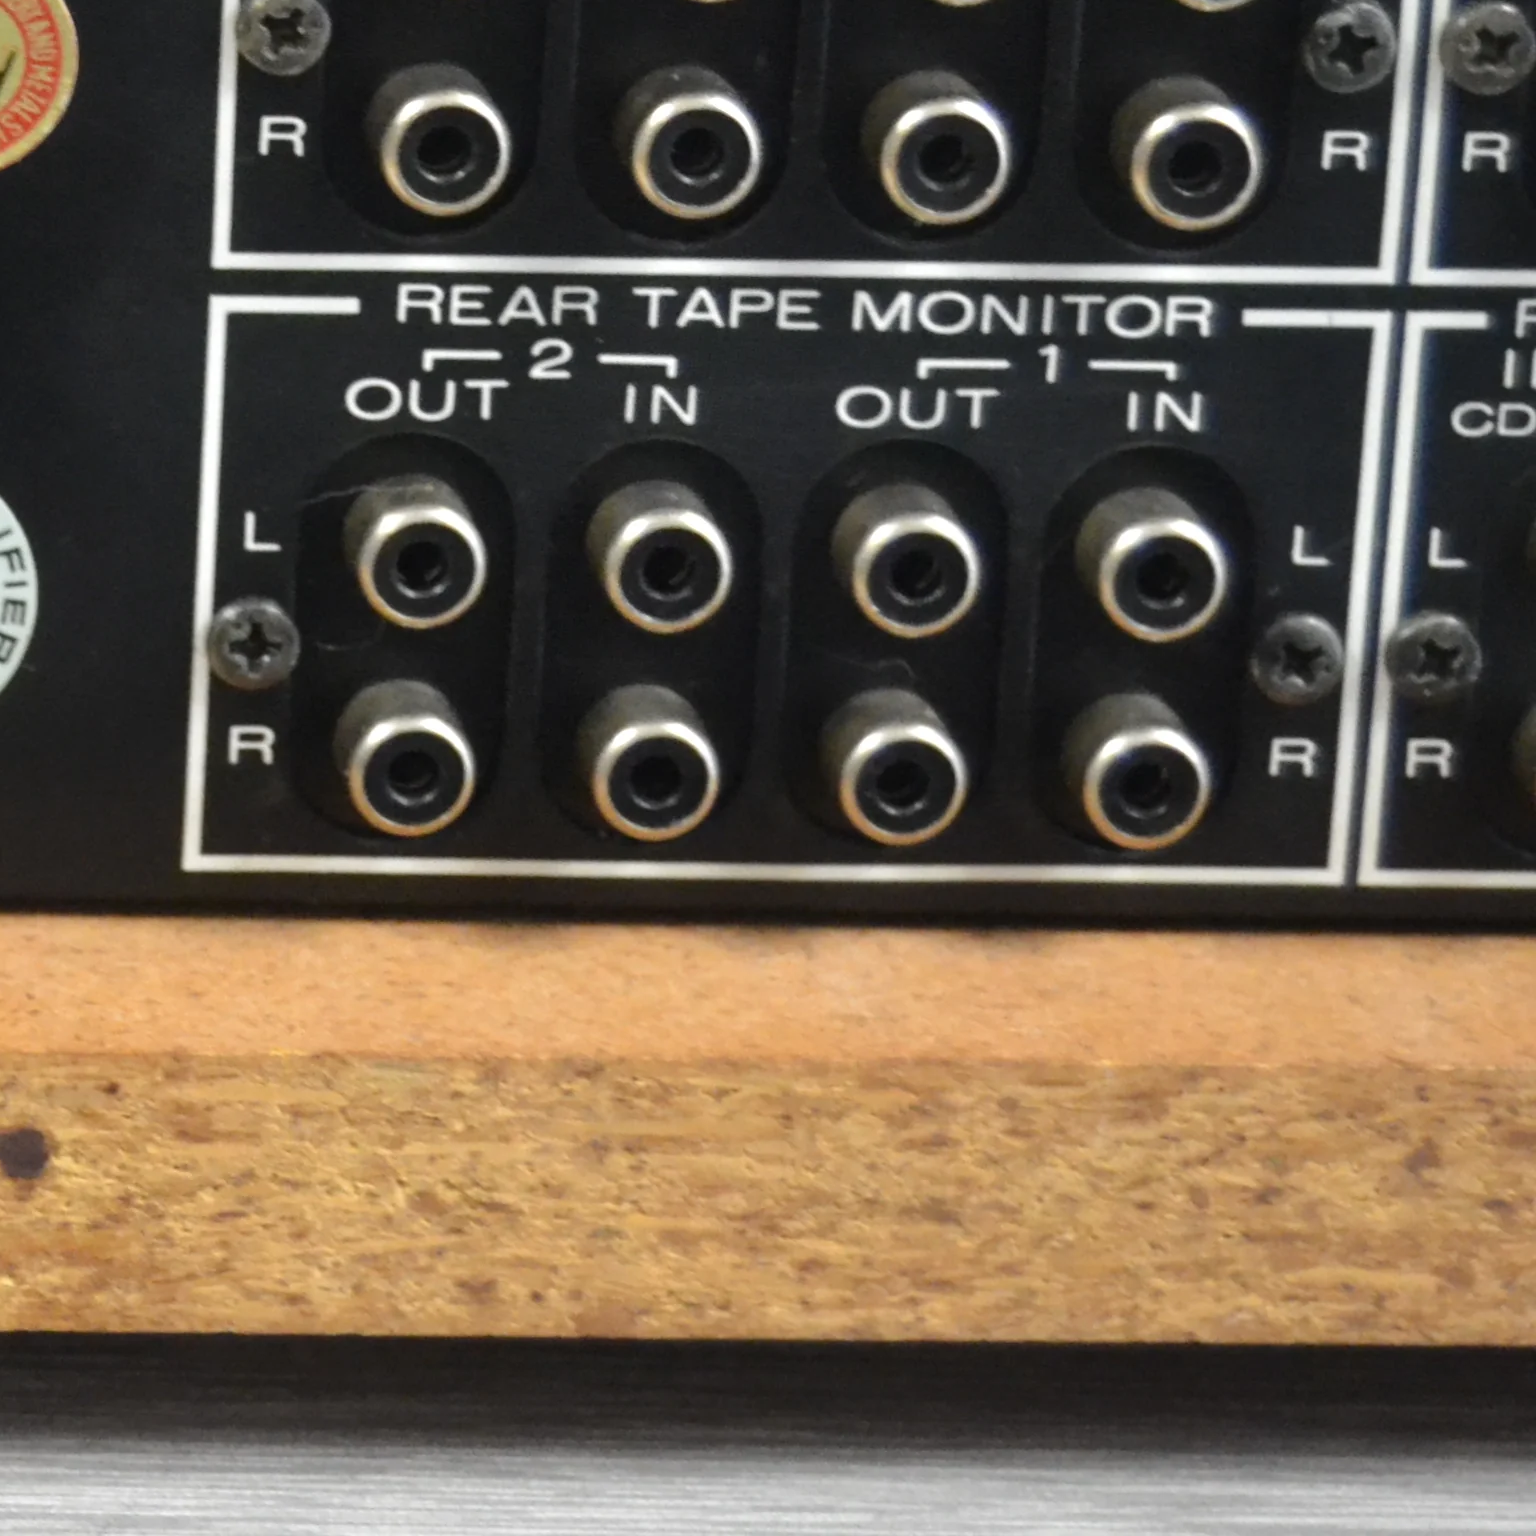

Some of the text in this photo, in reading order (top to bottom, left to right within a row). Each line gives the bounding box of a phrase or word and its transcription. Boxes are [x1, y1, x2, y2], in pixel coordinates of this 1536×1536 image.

[258, 115, 307, 157] R
[1321, 130, 1371, 171] R
[1462, 131, 1511, 173] R
[396, 282, 1214, 339] REAR TAPE MONITOR
[528, 338, 573, 380] 2
[1039, 344, 1060, 384] 1
[344, 377, 509, 422] OUT
[624, 384, 698, 425] IN
[835, 385, 1000, 430] OUT
[1127, 391, 1203, 432] IN
[243, 511, 281, 552] L
[1291, 525, 1330, 567] L
[1428, 527, 1467, 569] L
[228, 725, 276, 765] R
[1268, 737, 1318, 777] R
[1405, 738, 1454, 778] R
